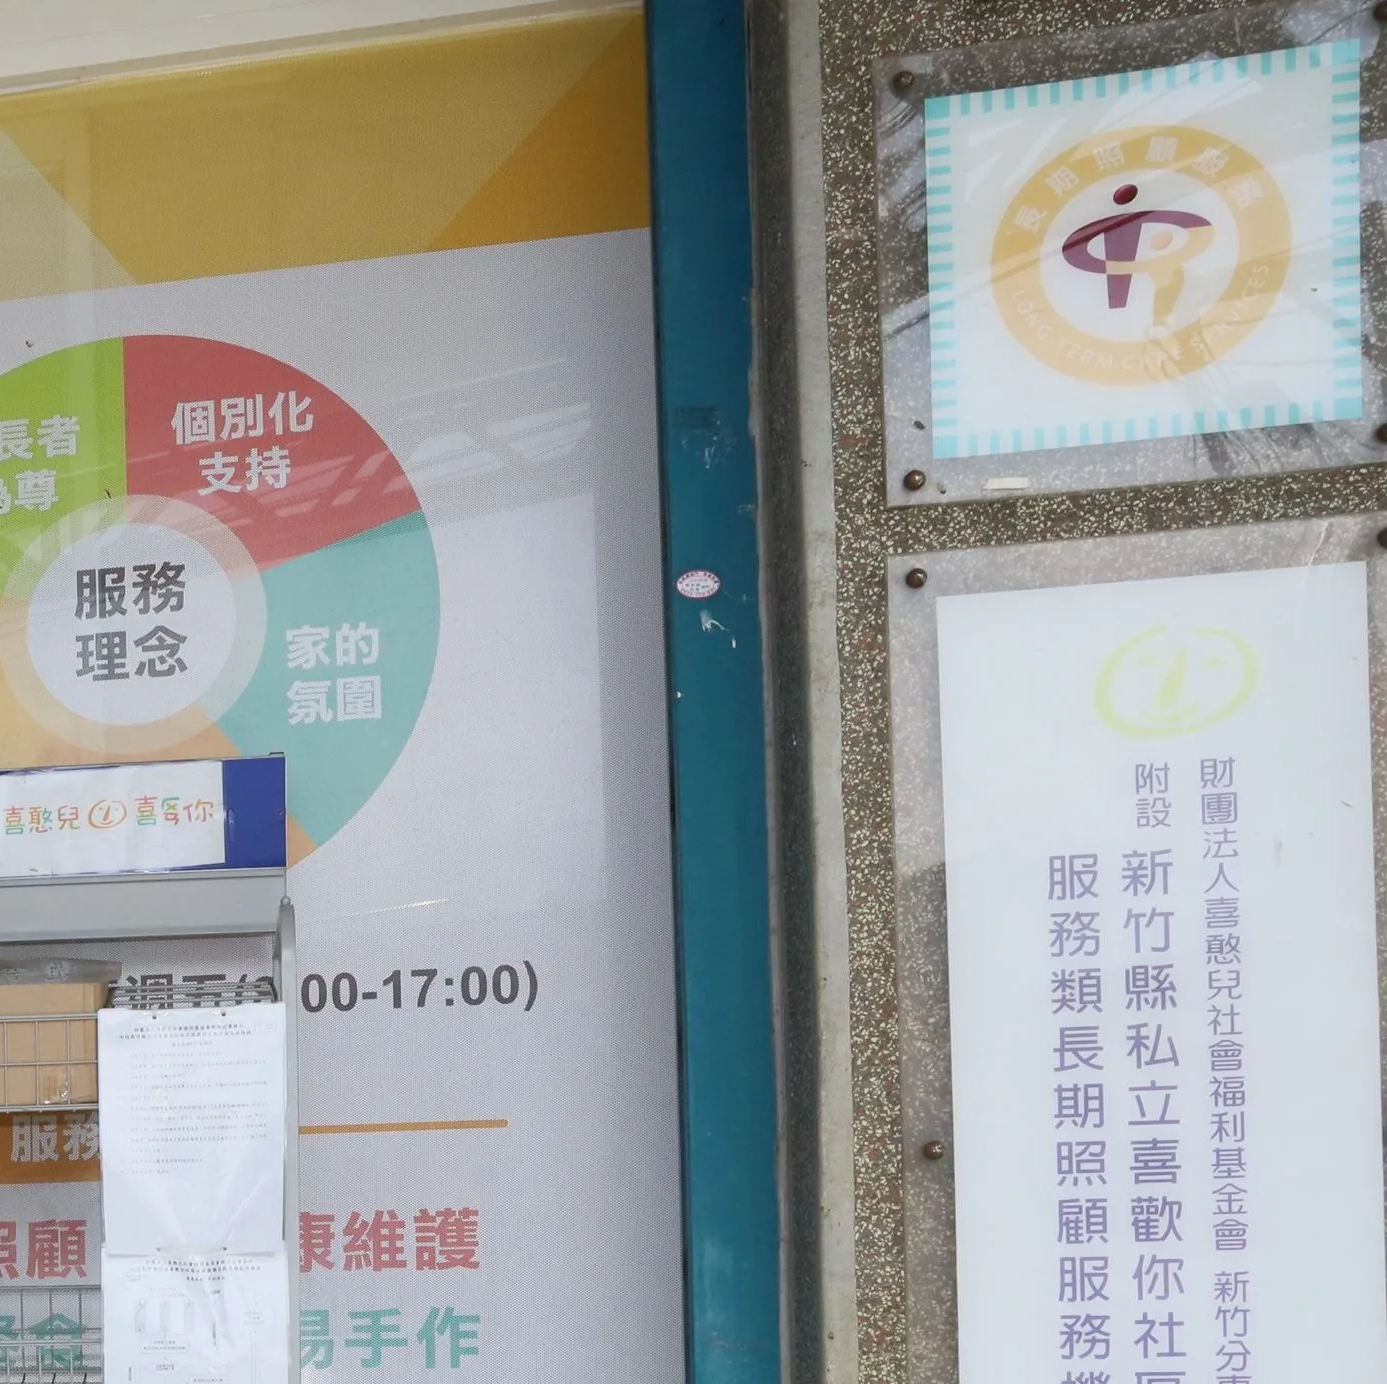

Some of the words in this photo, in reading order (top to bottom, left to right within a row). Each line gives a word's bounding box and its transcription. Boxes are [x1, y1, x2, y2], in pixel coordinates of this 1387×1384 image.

[1057, 337, 1113, 370] TERM
[171, 390, 315, 446] 個別化
[197, 444, 292, 496] 支持
[74, 561, 187, 621] 服務
[74, 624, 189, 683] 理念
[285, 621, 380, 670] 家的
[285, 675, 383, 727] 氛圍
[3, 805, 81, 835] 喜憨兒
[1135, 762, 1172, 829] 附設
[1200, 757, 1249, 1252] 財團法人喜憨兒社會福利基金會
[11, 1112, 99, 1162] 服務
